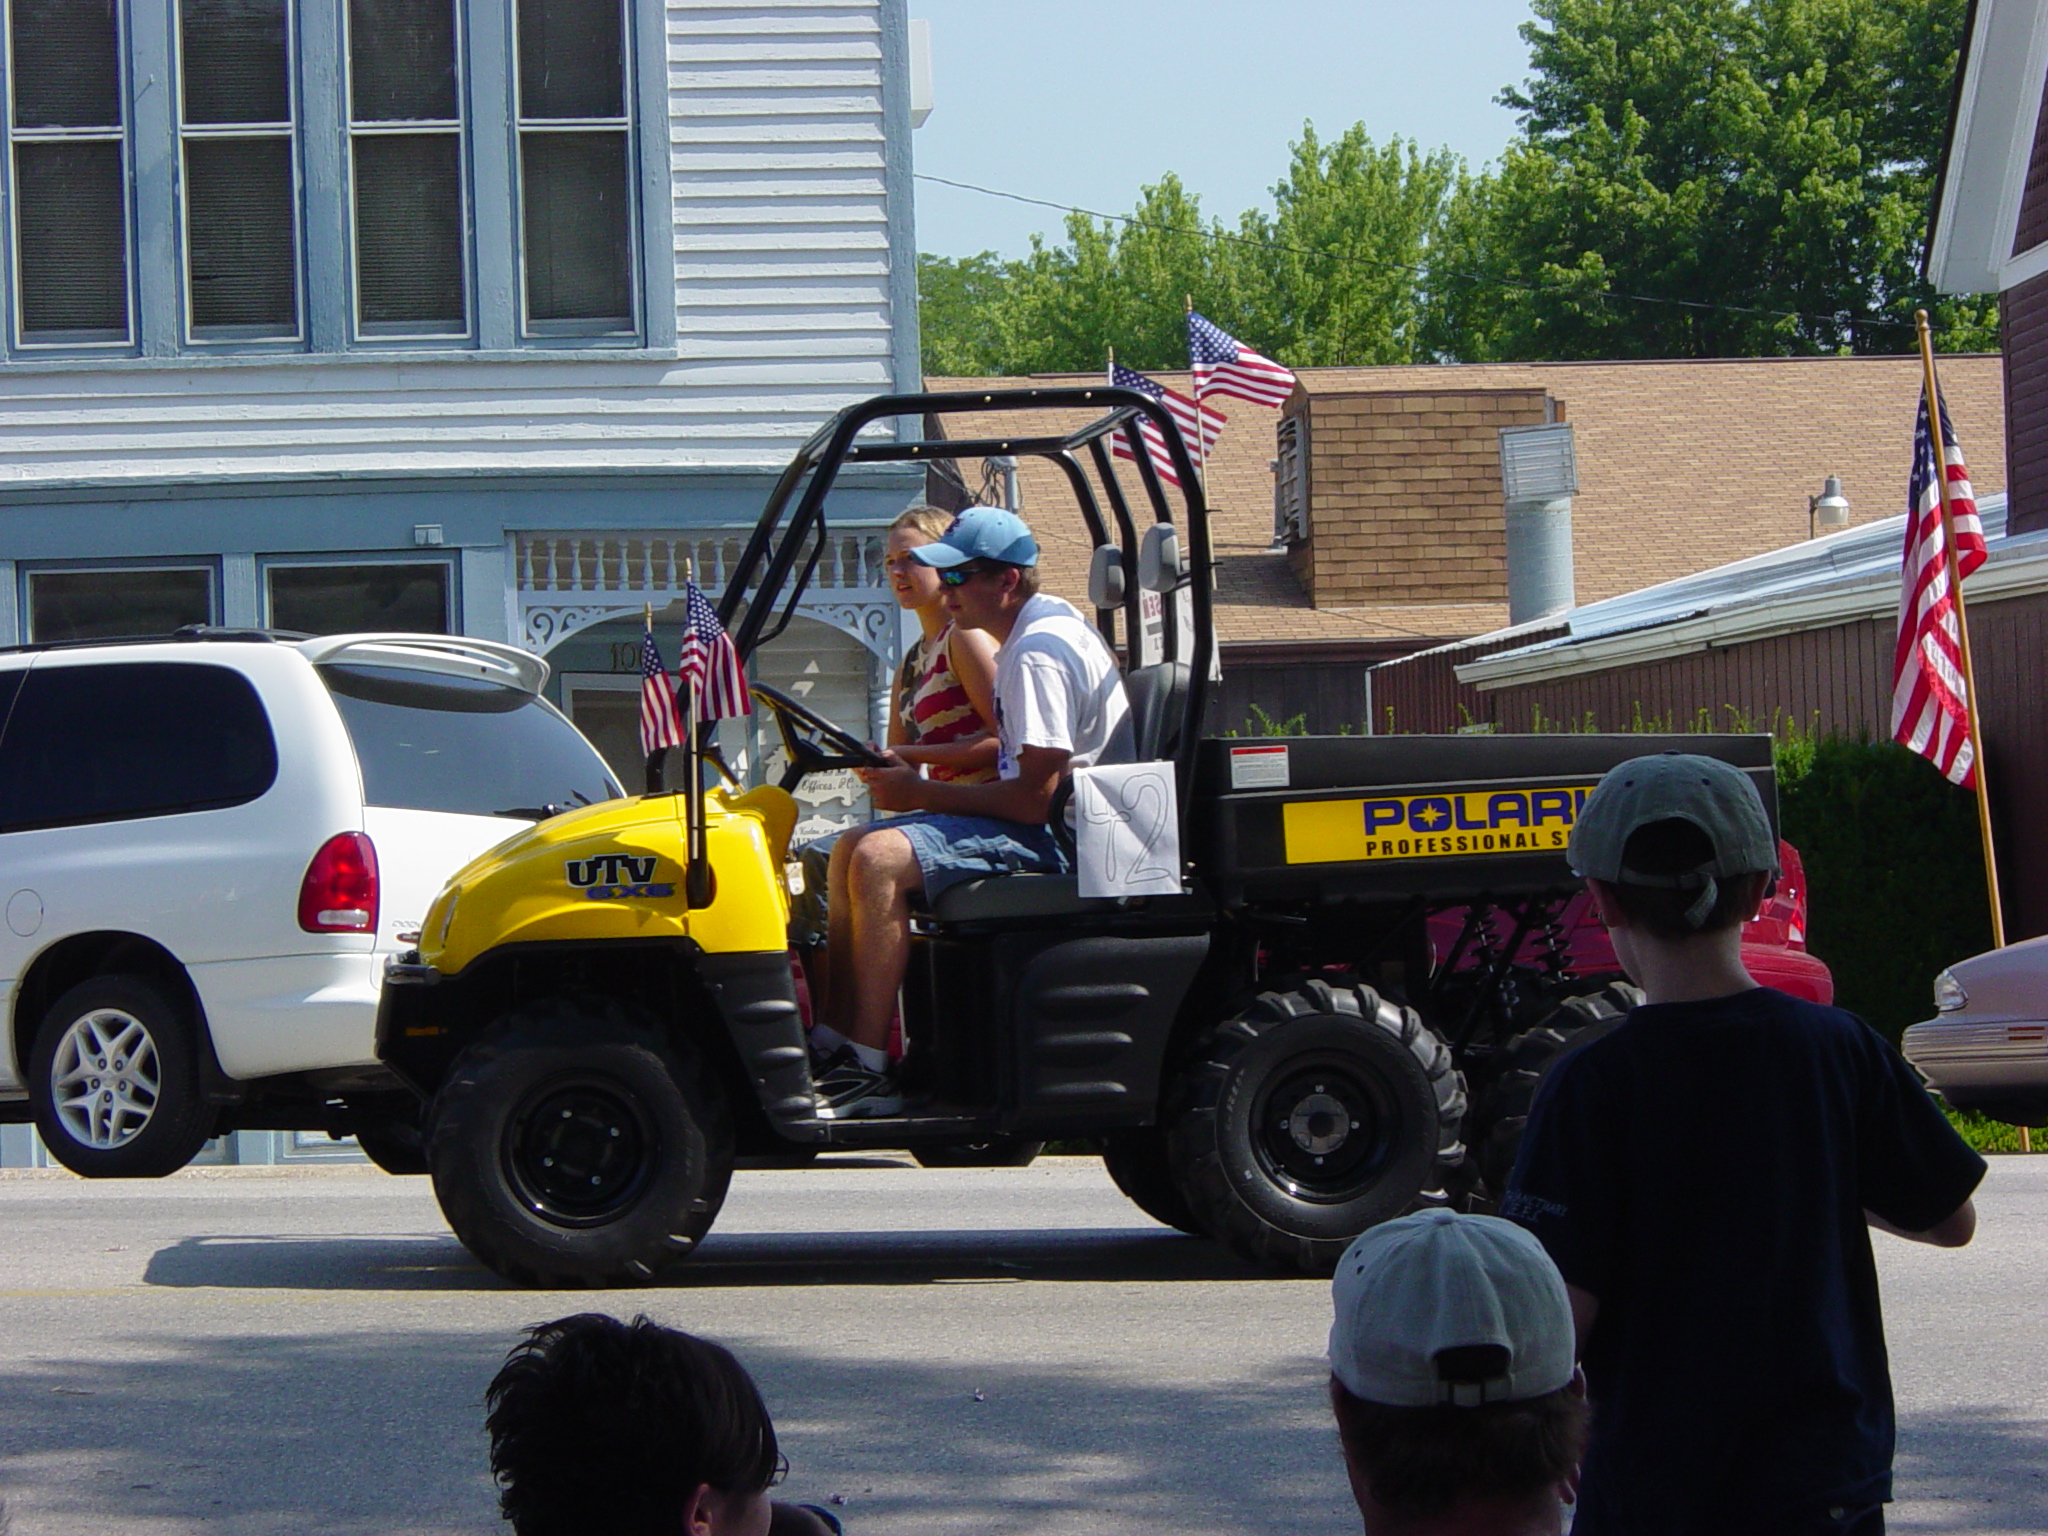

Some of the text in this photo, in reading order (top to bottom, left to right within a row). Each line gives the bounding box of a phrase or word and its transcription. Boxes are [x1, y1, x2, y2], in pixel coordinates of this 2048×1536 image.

[1081, 772, 1172, 885] 42
[1363, 790, 1586, 836] POLARI
[1366, 830, 1571, 857] PROFESSIONAL S
[564, 853, 657, 888] UTV
